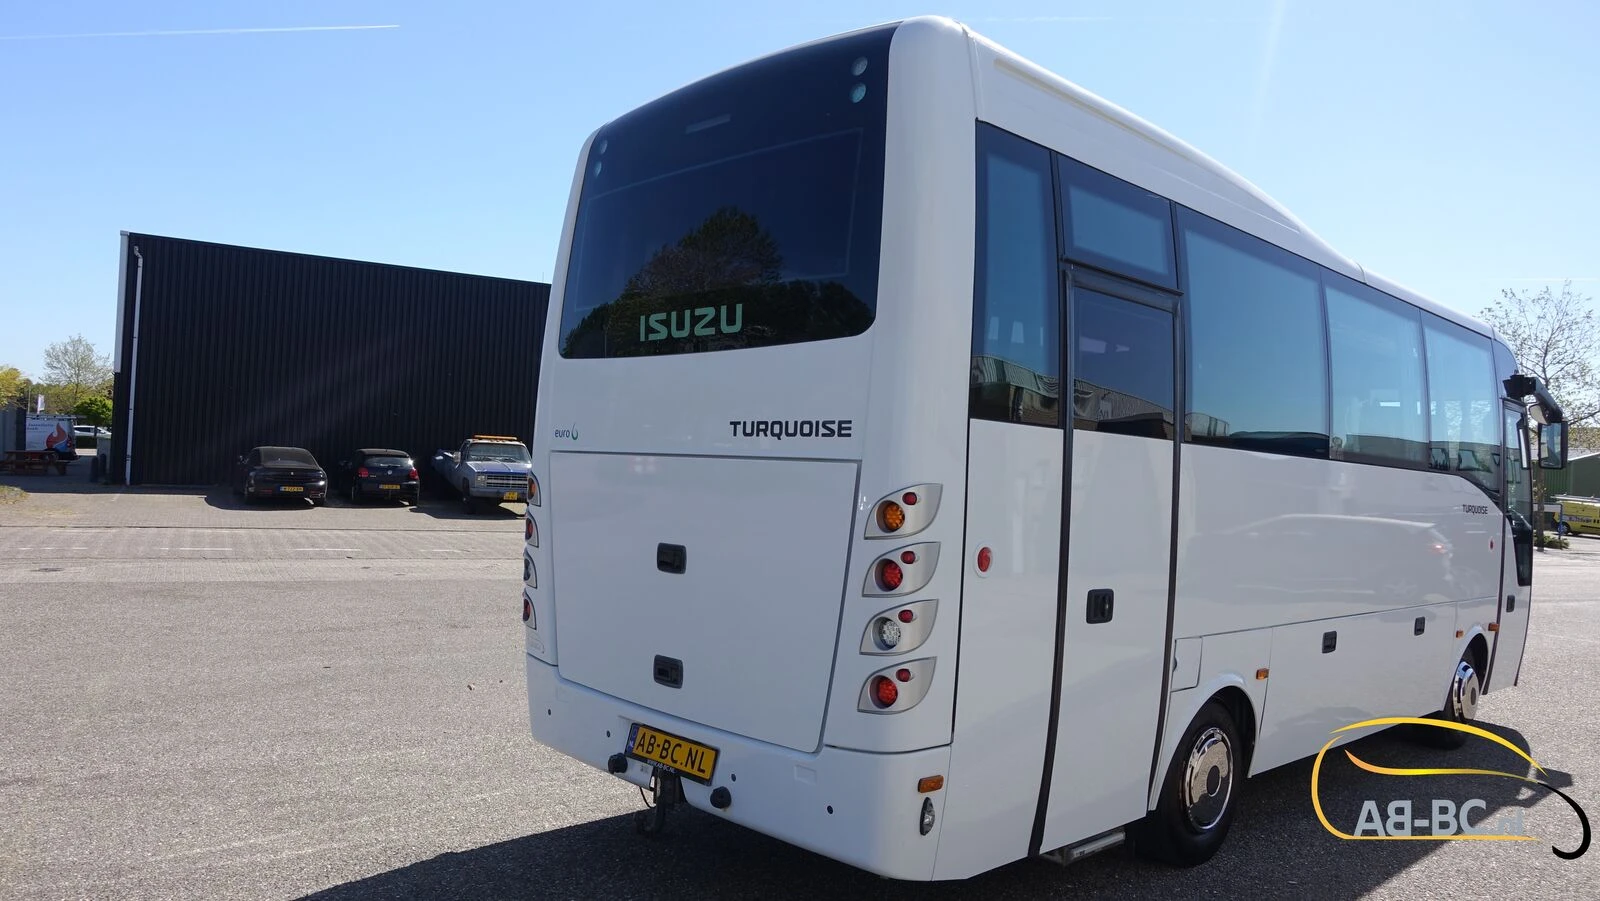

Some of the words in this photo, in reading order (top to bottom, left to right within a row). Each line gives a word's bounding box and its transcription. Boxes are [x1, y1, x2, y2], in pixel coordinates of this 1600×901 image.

[640, 303, 743, 342] ISUZU
[729, 419, 853, 441] TURQUOISE
[1462, 504, 1488, 515] TURQUOISE
[635, 732, 706, 774] AB-BC.NL
